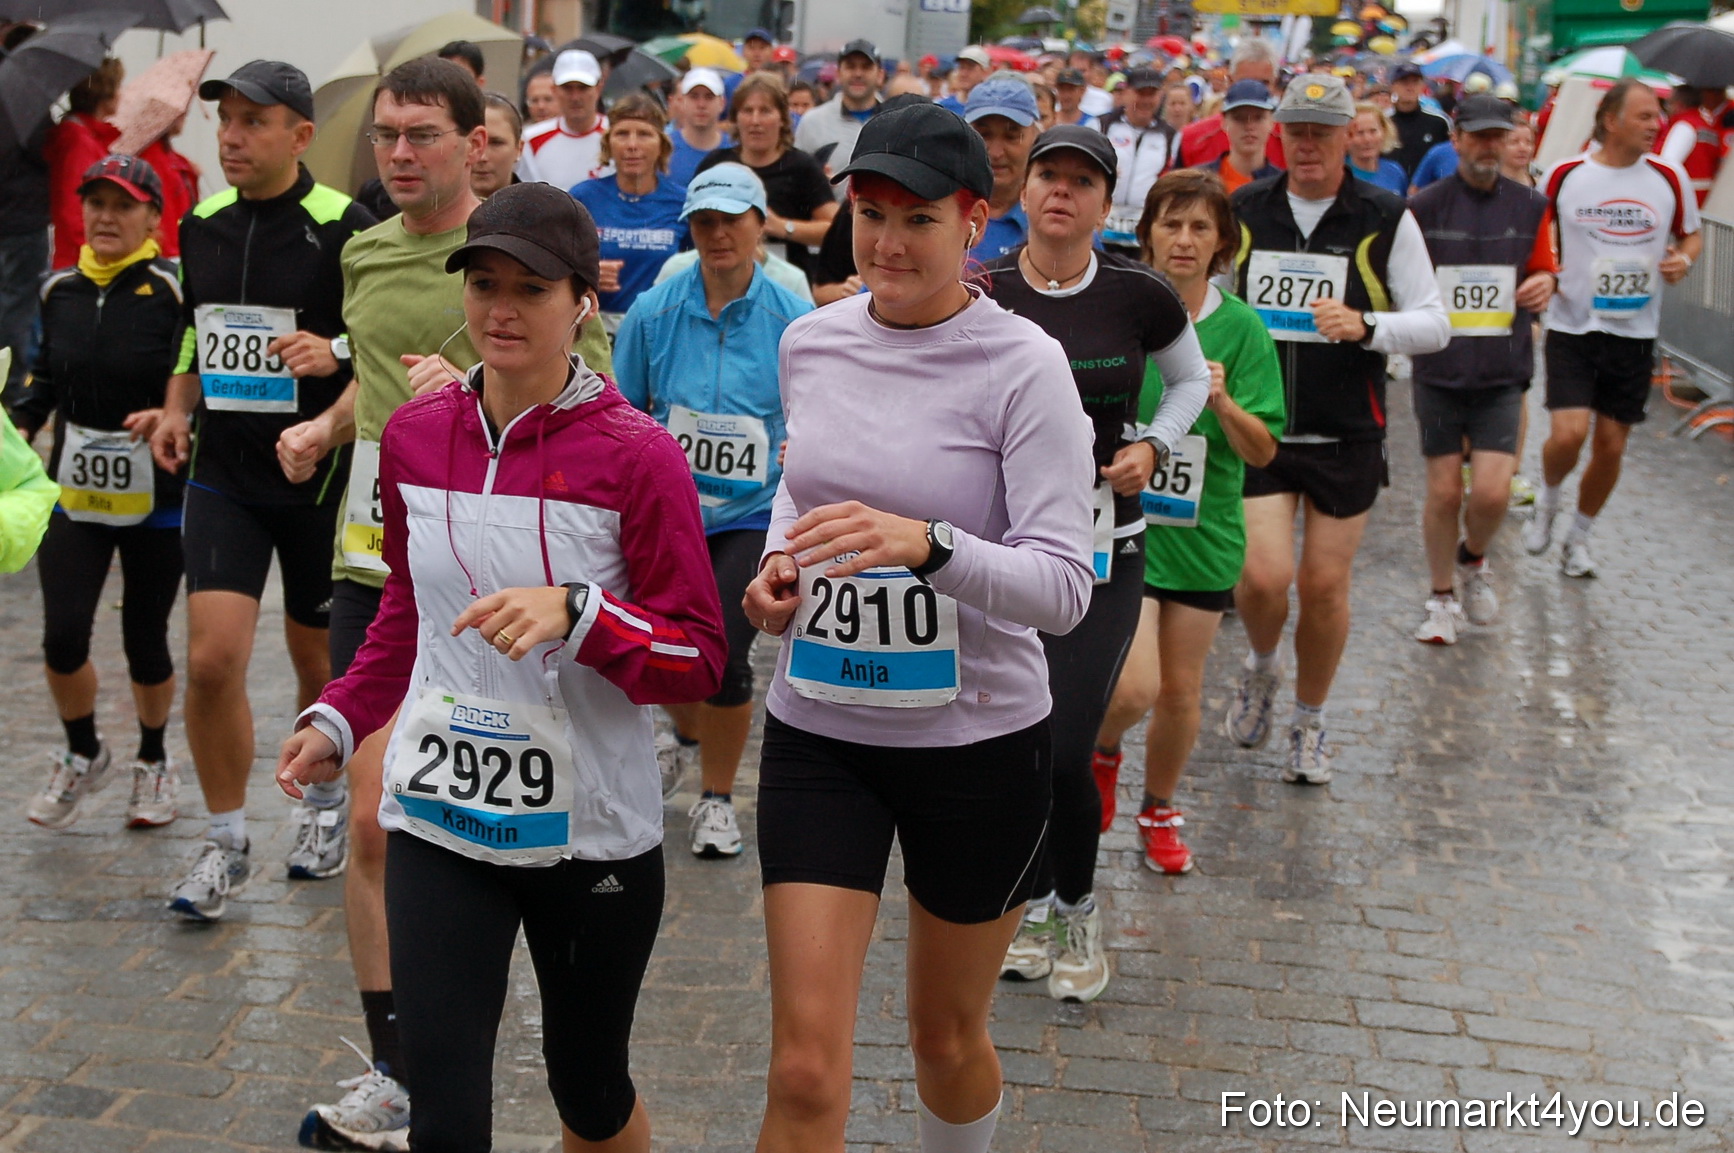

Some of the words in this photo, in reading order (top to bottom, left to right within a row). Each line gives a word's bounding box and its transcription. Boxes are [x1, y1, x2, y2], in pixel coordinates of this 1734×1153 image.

[1257, 275, 1333, 308] 2870
[1453, 285, 1499, 310] 692
[211, 379, 268, 397] Gerhard
[72, 453, 131, 490] 399
[806, 577, 938, 646] 2910
[841, 658, 889, 687] Anja
[452, 705, 510, 729] BOCK
[408, 734, 554, 808] 2929
[441, 806, 518, 843] Kathrin
